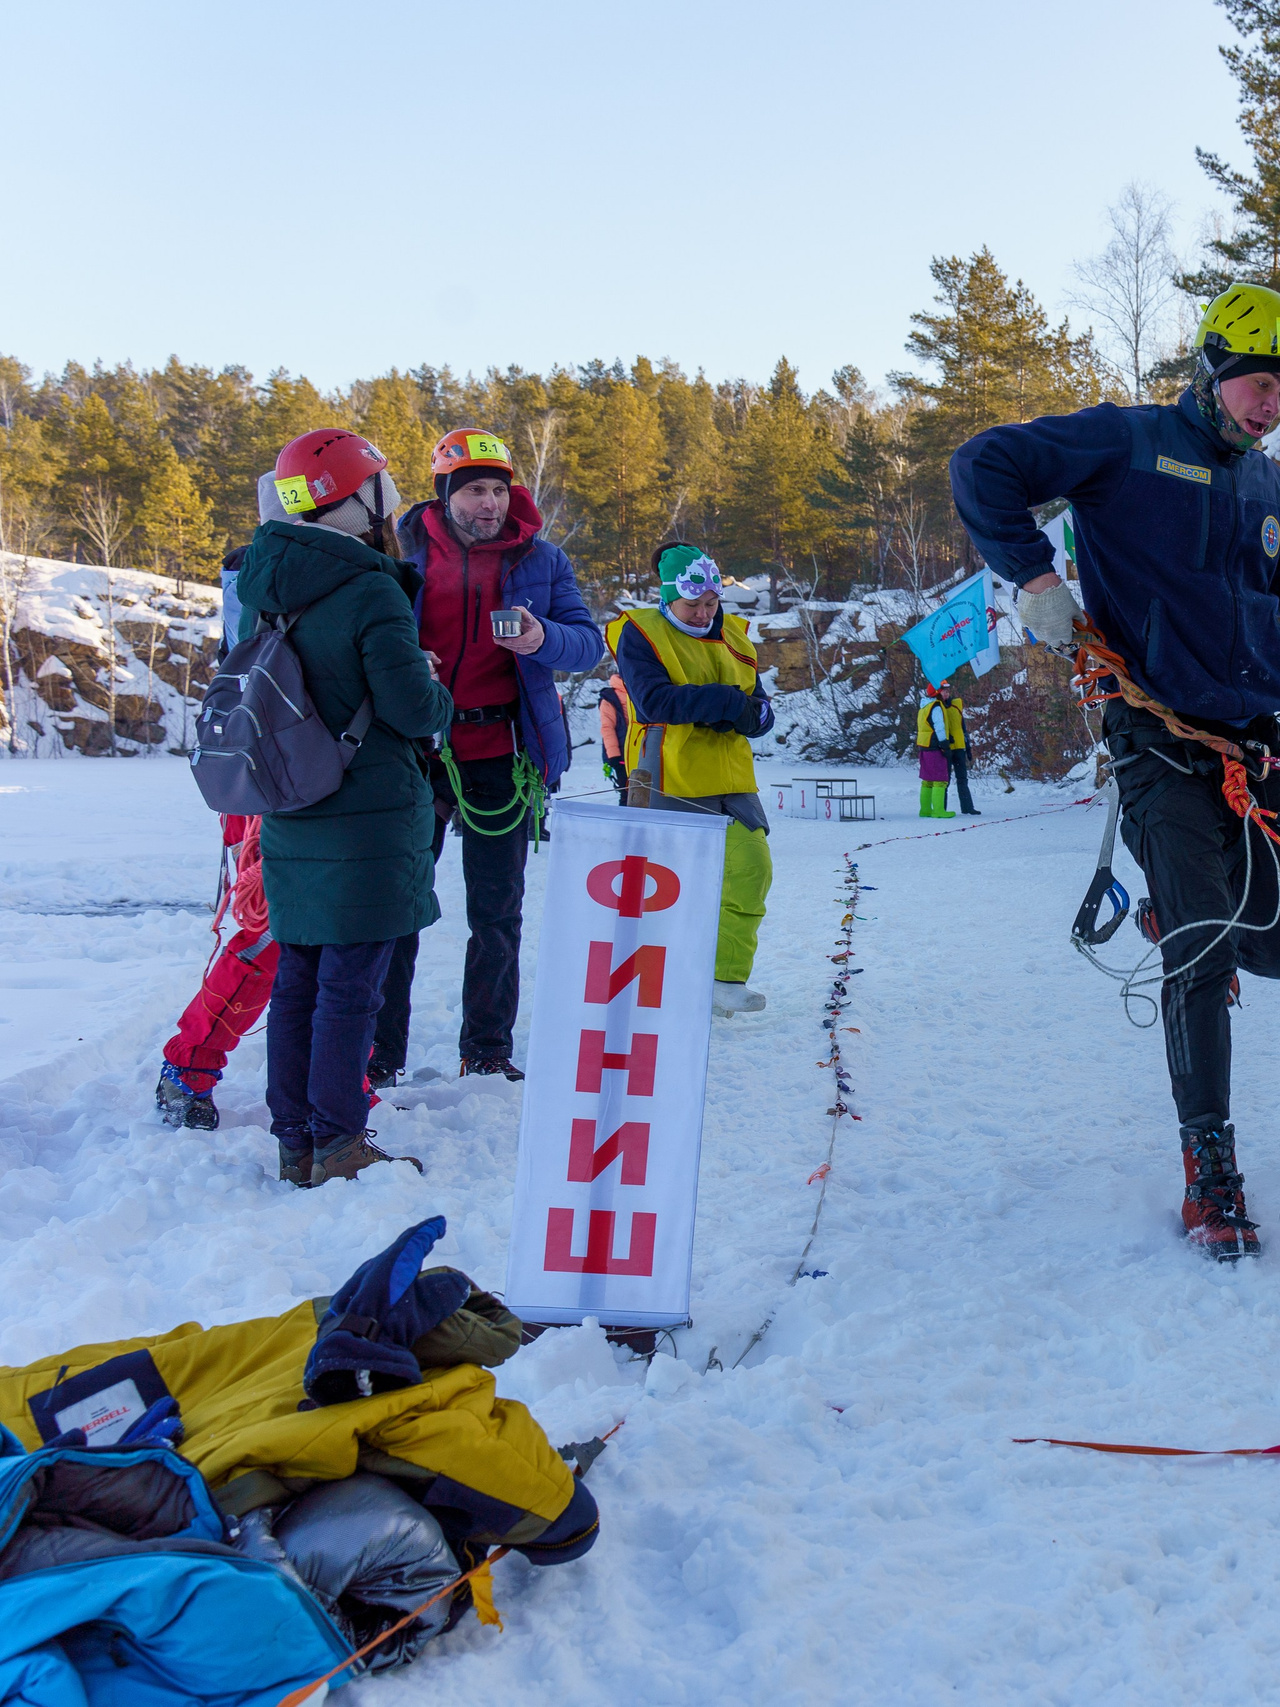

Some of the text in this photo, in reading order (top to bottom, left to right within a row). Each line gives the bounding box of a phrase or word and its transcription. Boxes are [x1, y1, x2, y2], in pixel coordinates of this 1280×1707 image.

[479, 441, 498, 454] 5.1
[1161, 460, 1208, 480] EMERCOM
[281, 489, 301, 505] 5.2
[778, 791, 783, 810] 2
[801, 790, 805, 808] 1
[825, 799, 831, 819] 3
[543, 855, 681, 1276] ФИНИШ
